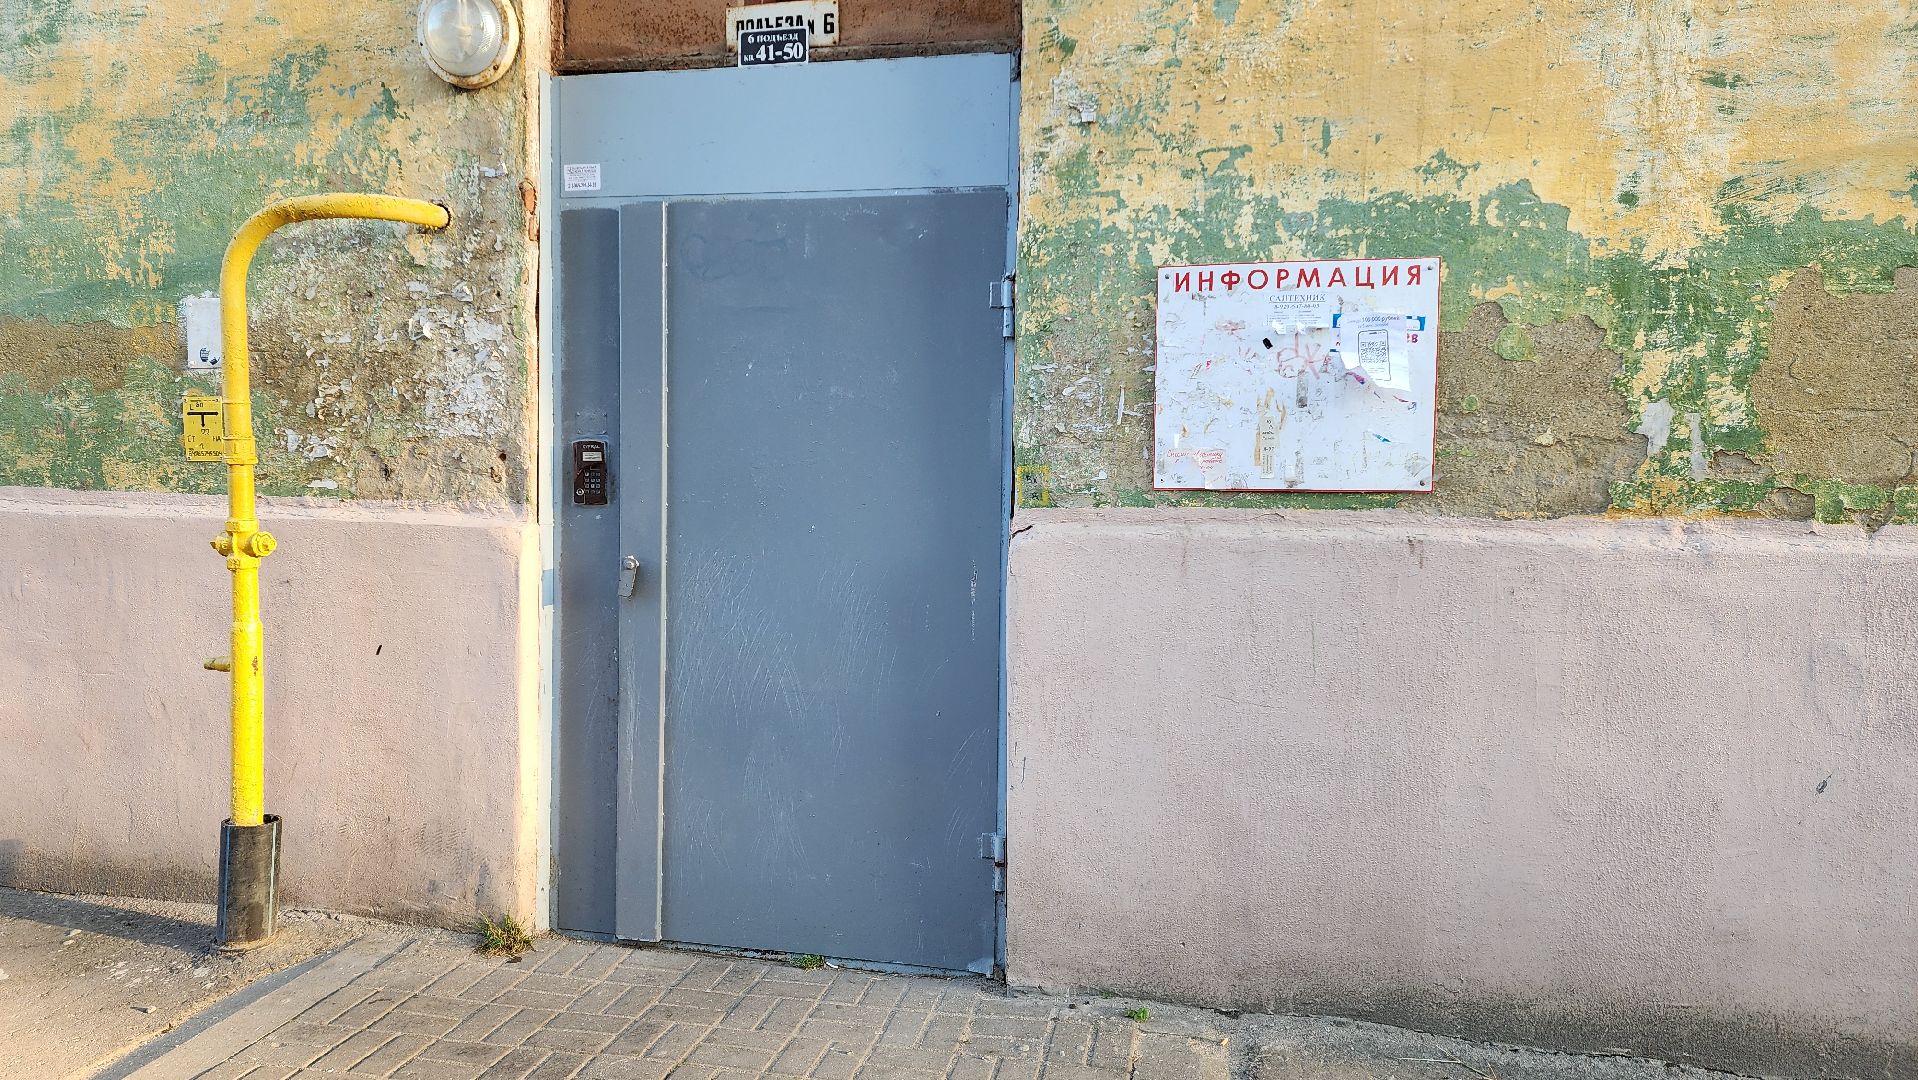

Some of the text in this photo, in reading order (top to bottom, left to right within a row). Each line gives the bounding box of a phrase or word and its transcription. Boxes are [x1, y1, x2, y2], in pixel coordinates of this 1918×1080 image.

[824, 13, 834, 34] 6
[747, 33, 799, 44] 6 ПОДЪЕЗД
[755, 42, 804, 61] 41-50
[1174, 265, 1421, 293] ИНФОРМАЦИЯ
